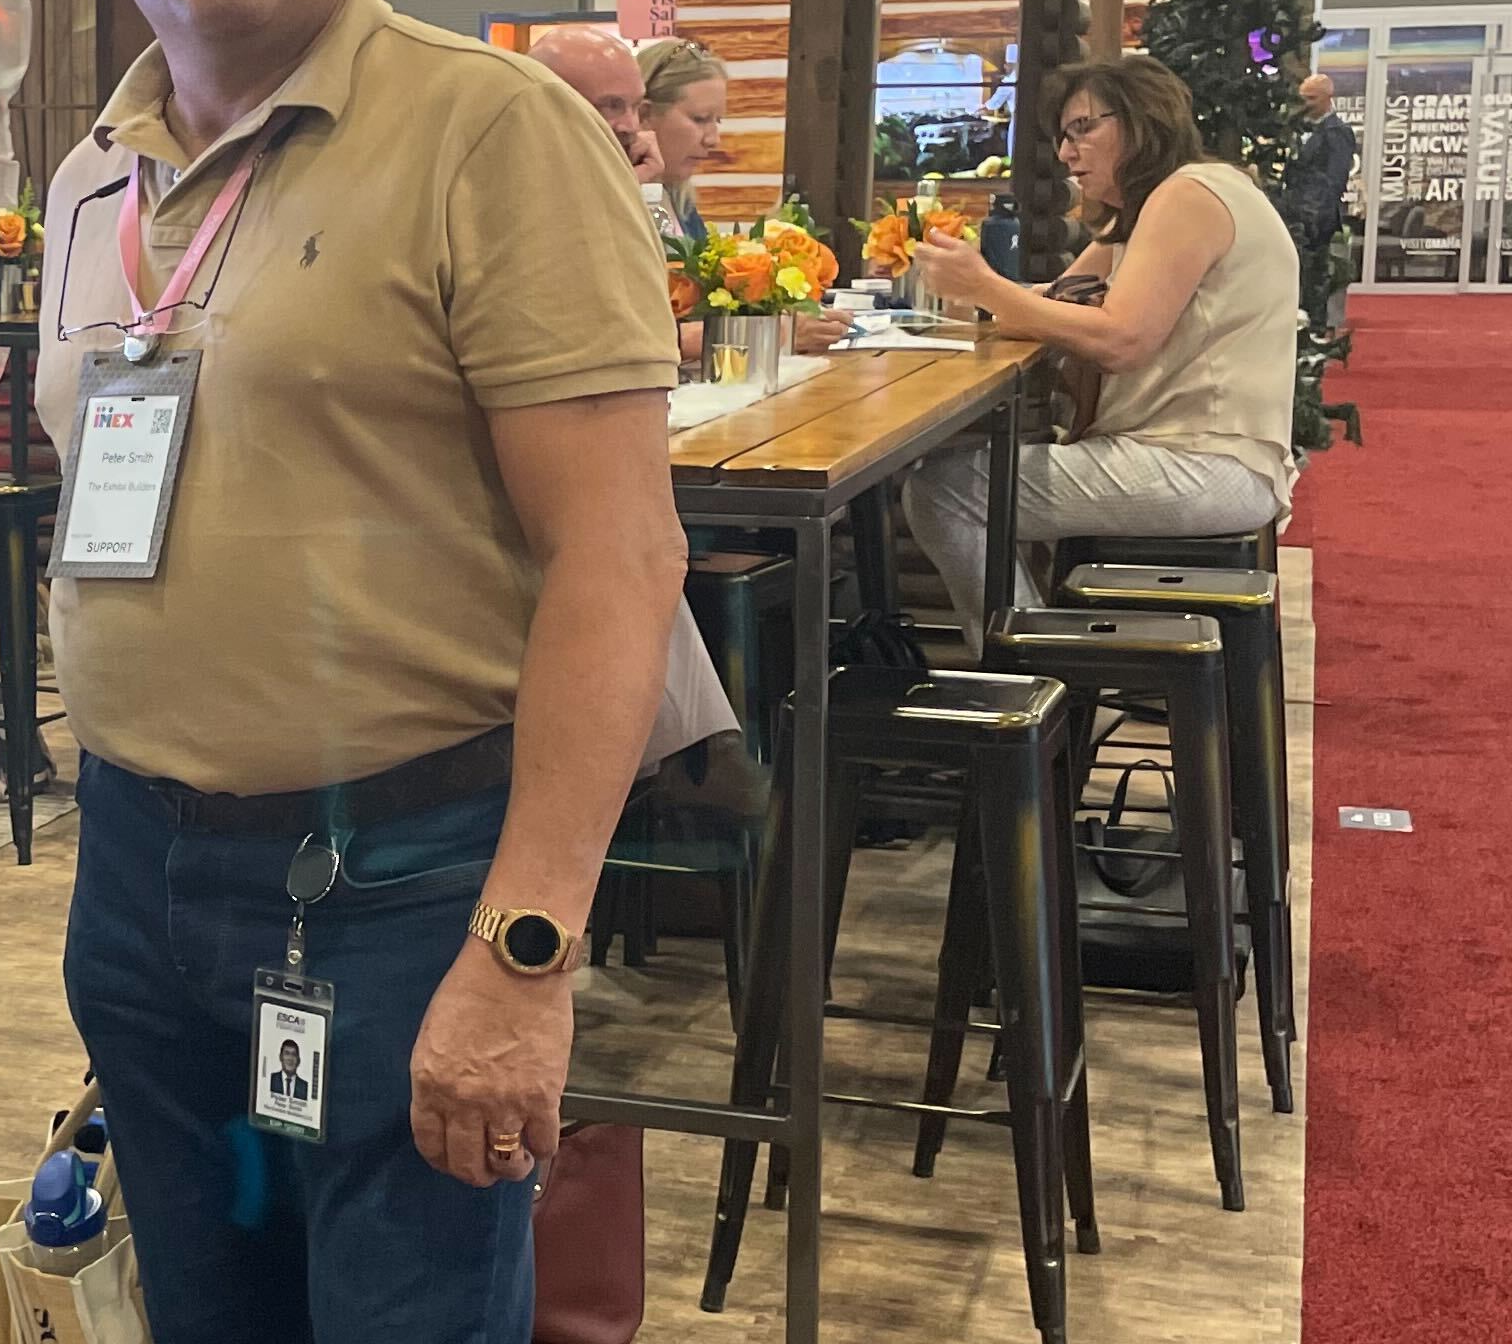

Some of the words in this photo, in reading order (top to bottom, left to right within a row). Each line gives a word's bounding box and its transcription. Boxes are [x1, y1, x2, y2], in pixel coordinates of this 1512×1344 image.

[649, 6, 675, 21] Sal
[1381, 95, 1409, 201] MUSEUMS
[1475, 109, 1506, 200] VALUE
[102, 452, 126, 464] Peter
[128, 452, 154, 464] Smith
[87, 542, 134, 553] SUPPORT
